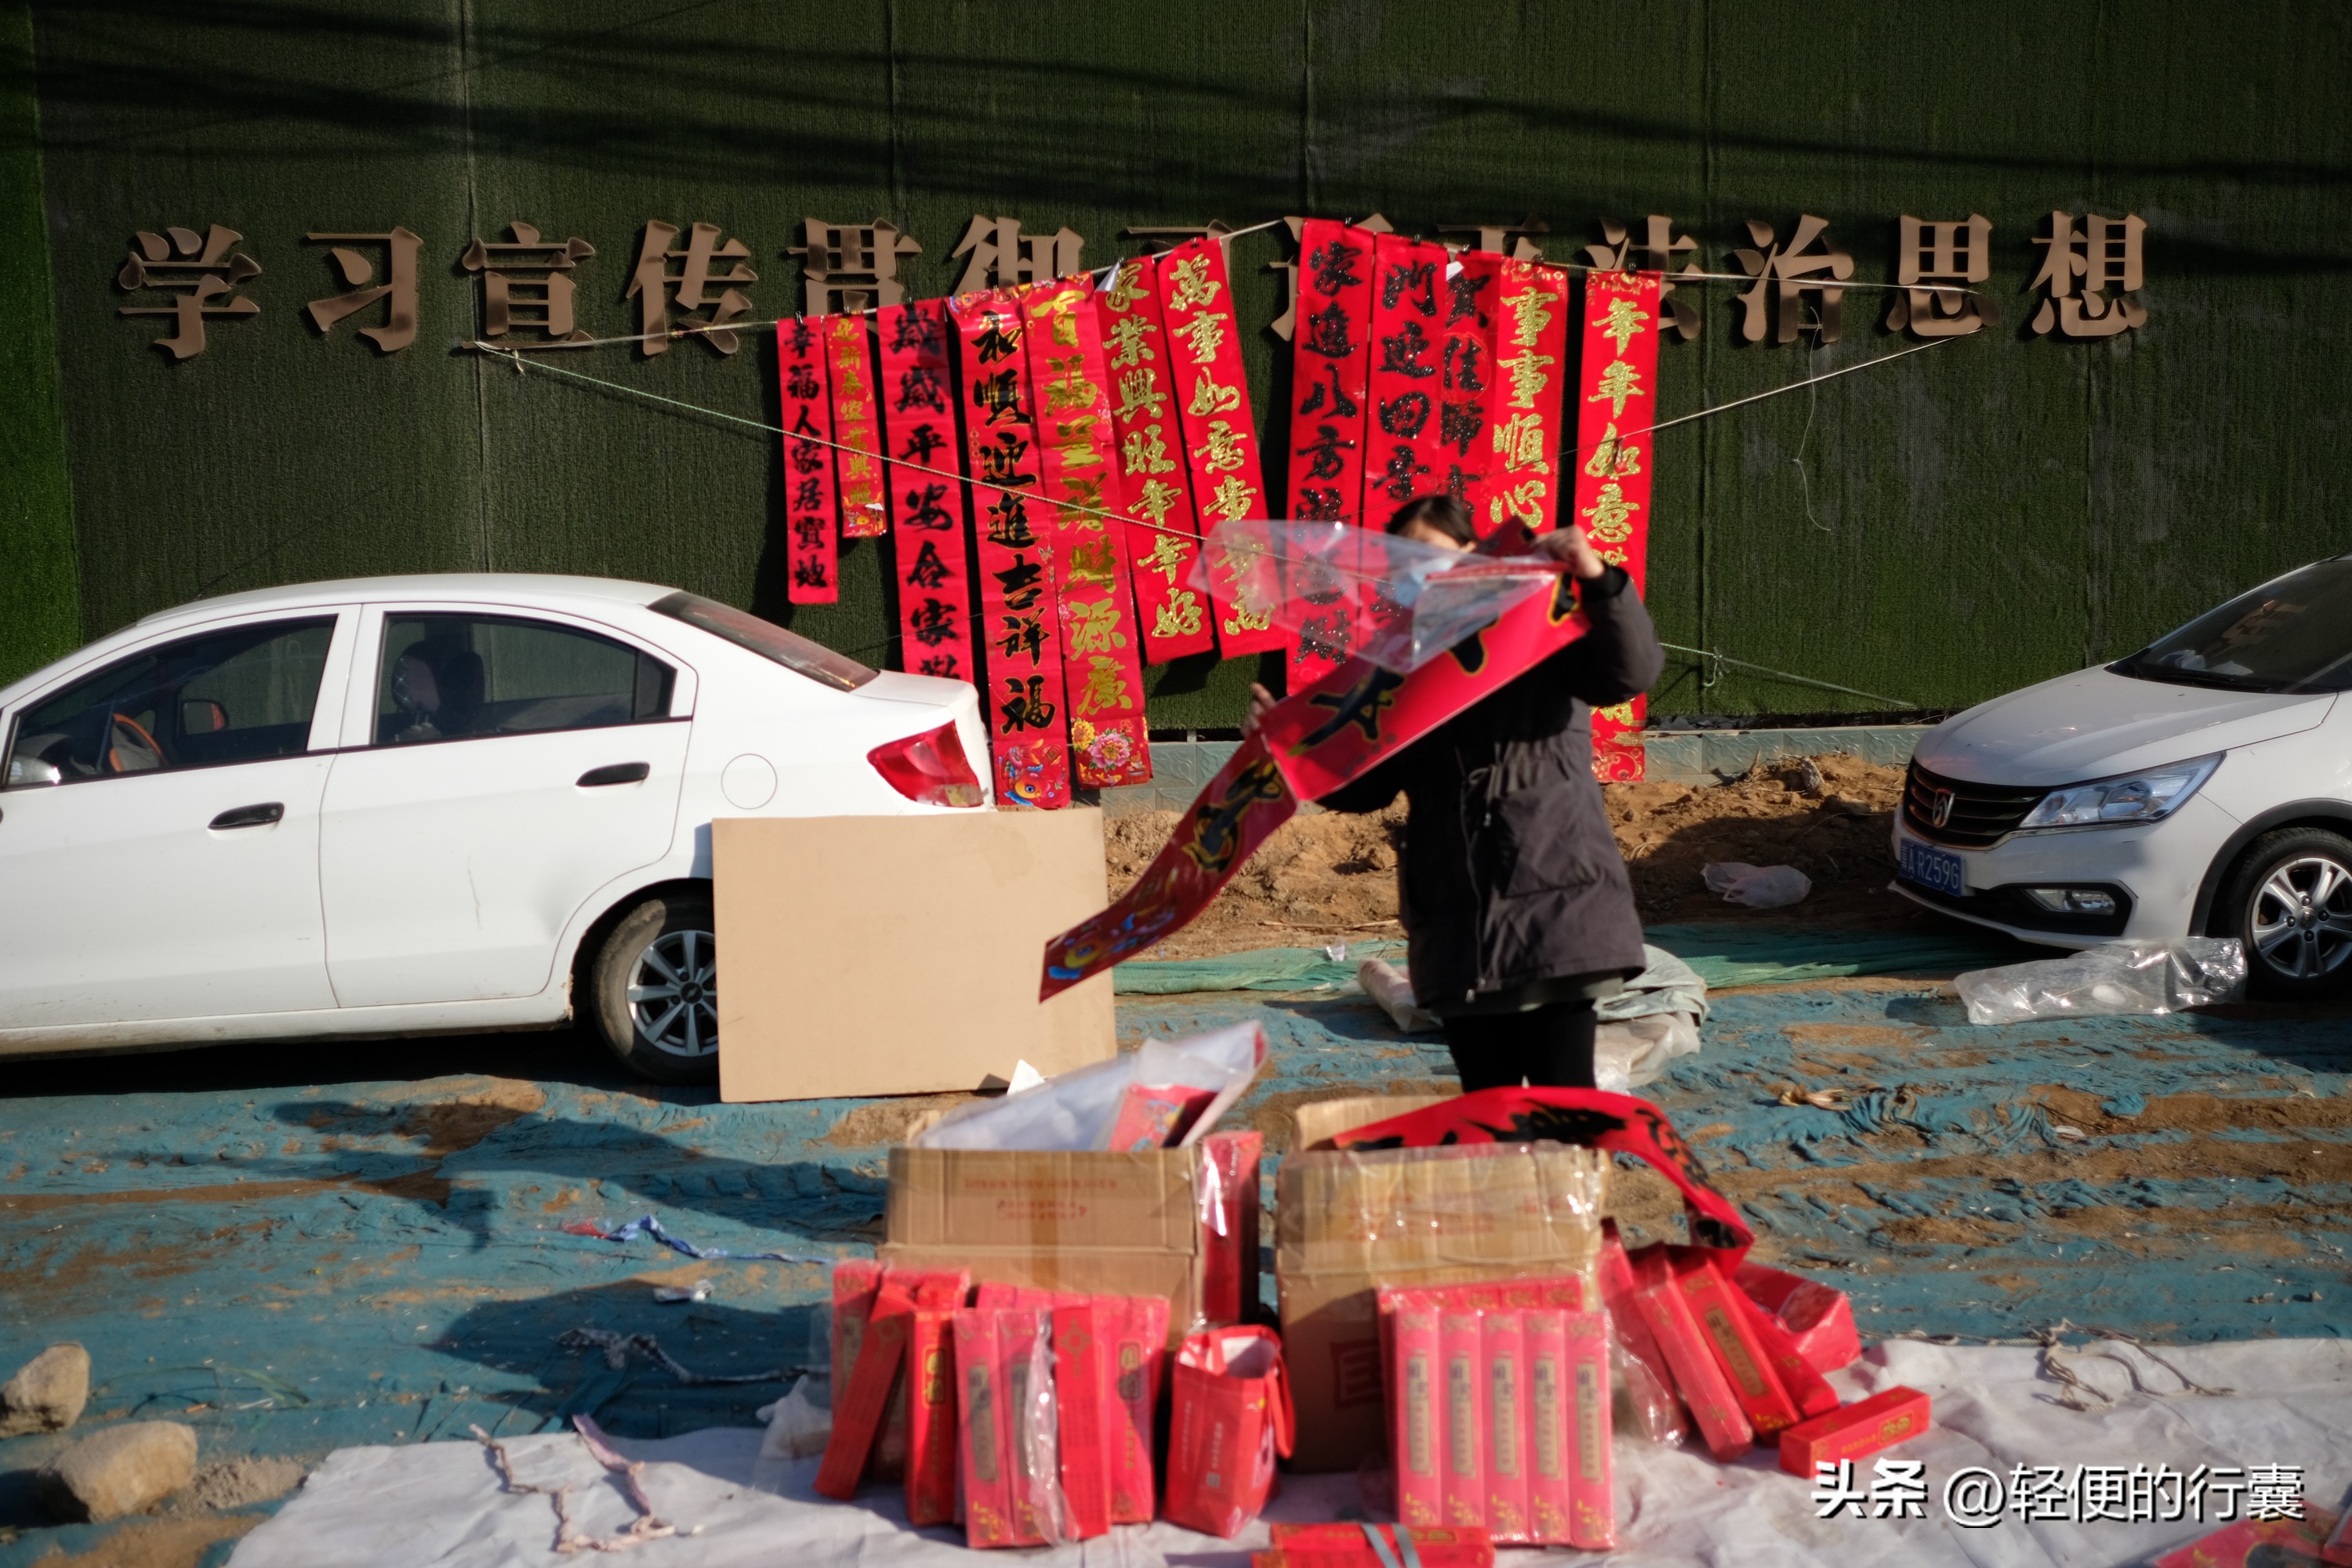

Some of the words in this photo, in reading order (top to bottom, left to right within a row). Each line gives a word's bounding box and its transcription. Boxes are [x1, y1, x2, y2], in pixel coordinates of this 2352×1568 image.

[119, 210, 2147, 359] 学习宣传贯彻法治思想
[1490, 286, 1559, 528] 事事順心
